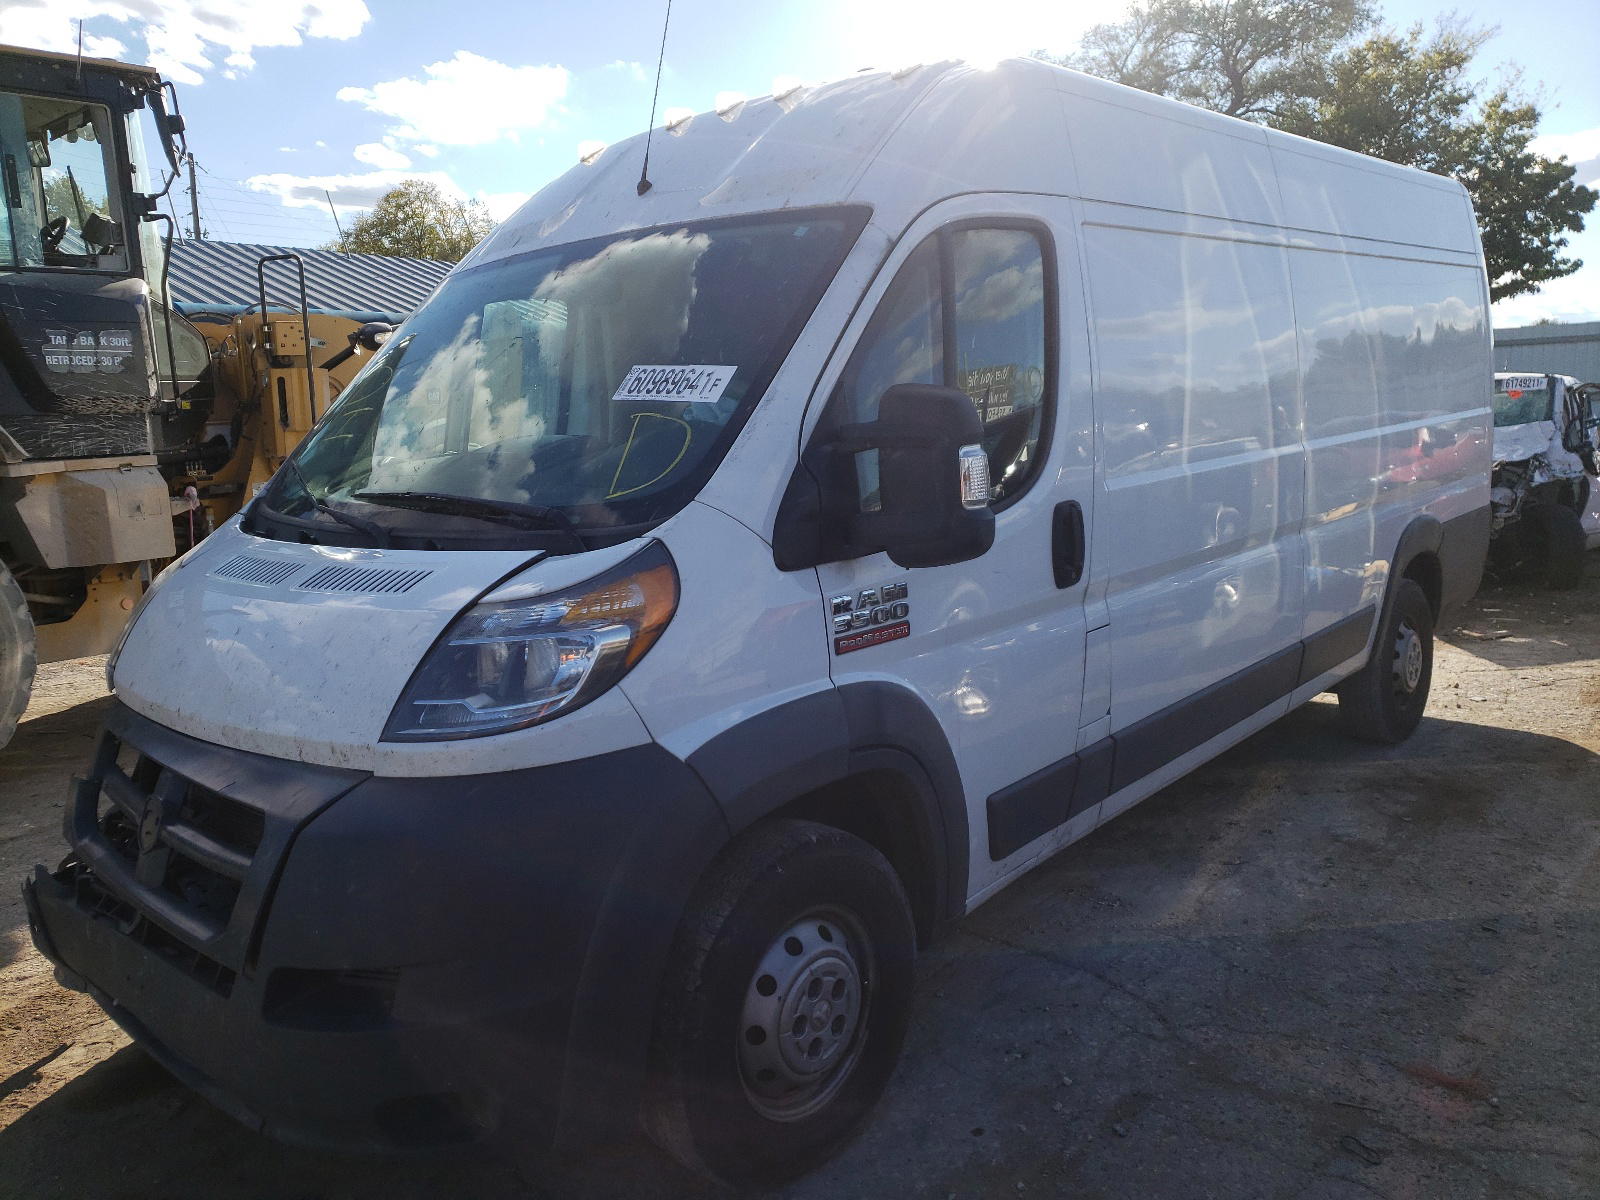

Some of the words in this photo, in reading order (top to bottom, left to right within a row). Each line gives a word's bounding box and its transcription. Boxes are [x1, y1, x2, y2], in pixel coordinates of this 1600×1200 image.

[79, 336, 107, 346] BAK
[603, 412, 692, 500] D
[830, 582, 908, 616] RAM
